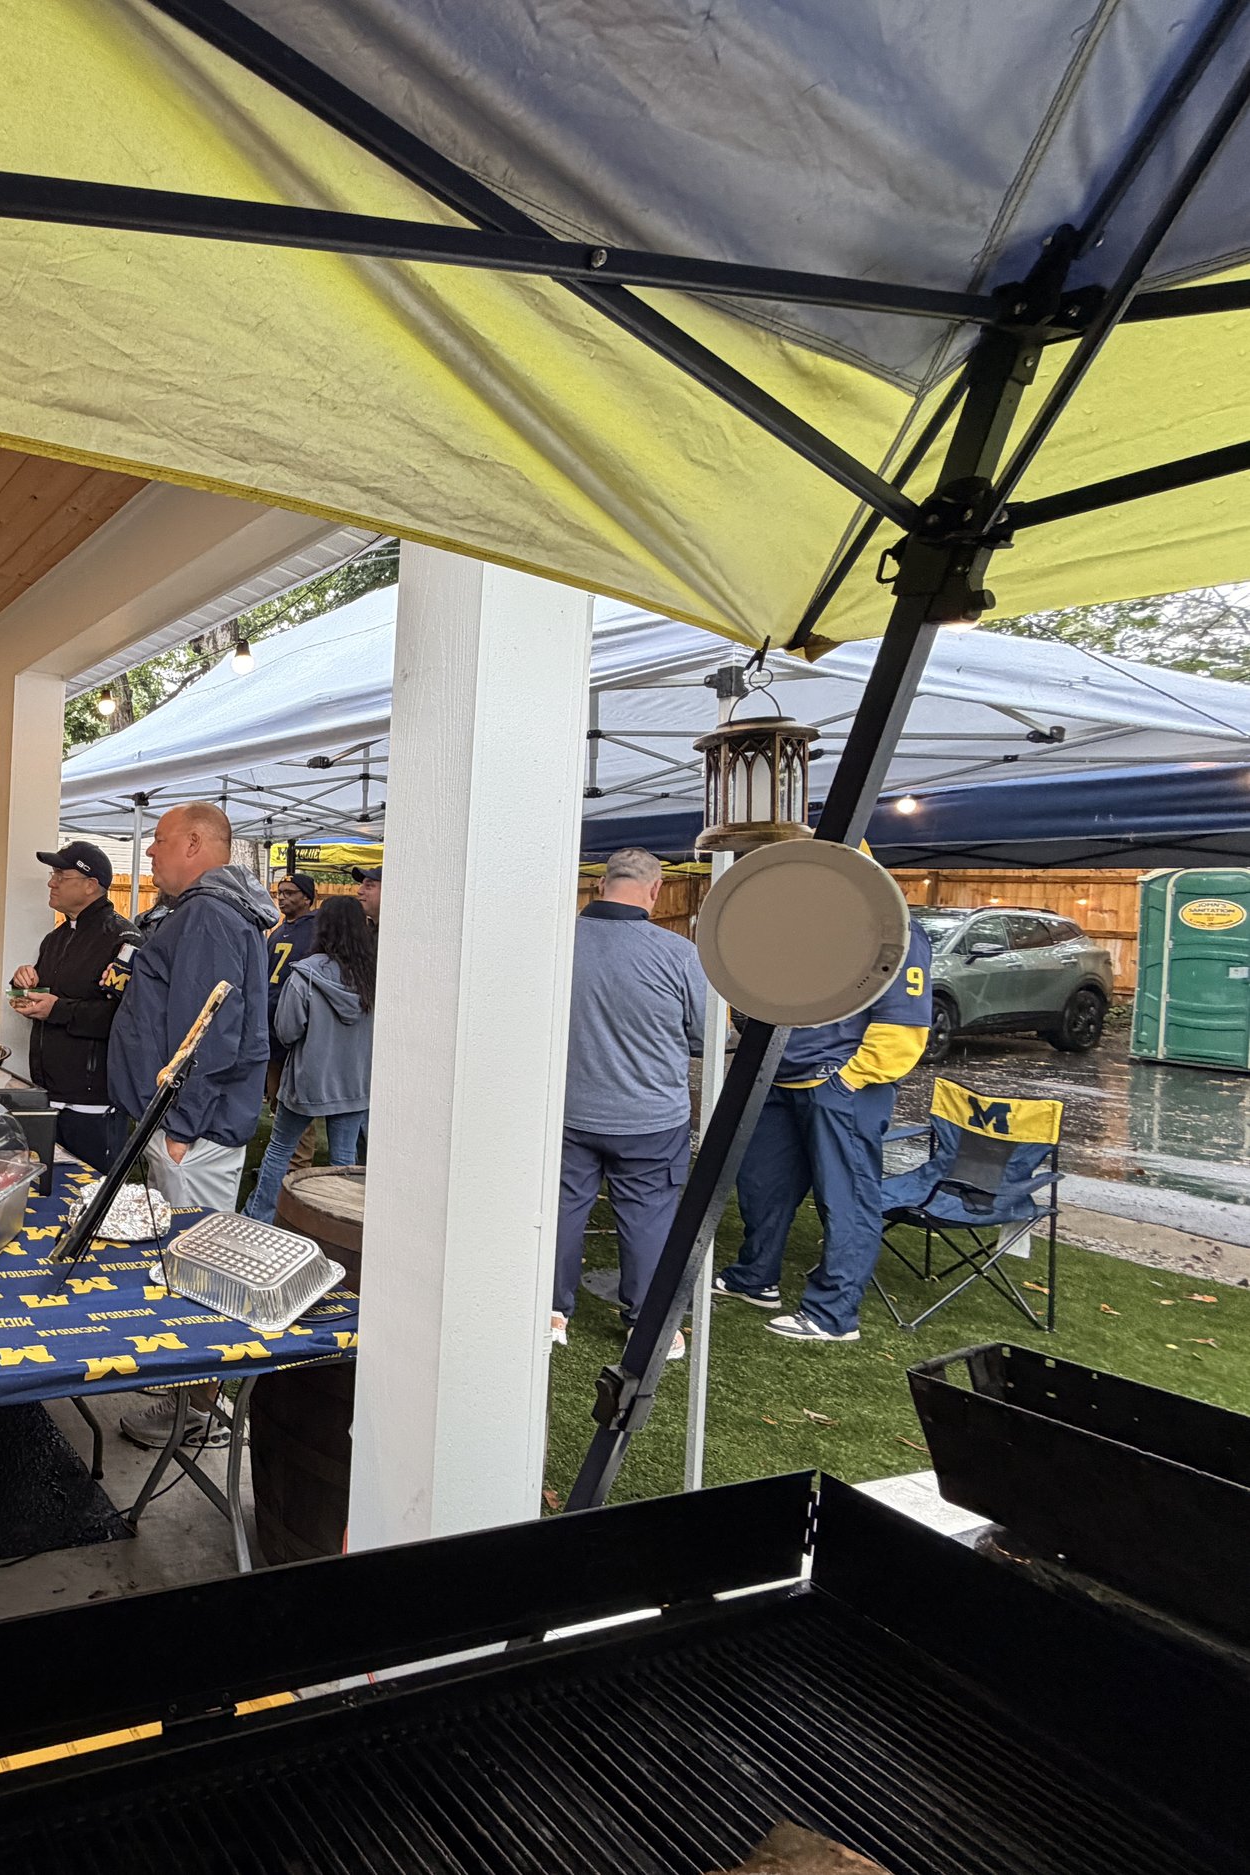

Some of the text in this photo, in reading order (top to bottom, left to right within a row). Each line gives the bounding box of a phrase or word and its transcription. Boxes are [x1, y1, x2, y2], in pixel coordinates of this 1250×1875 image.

[269, 943, 293, 984] 7
[104, 968, 131, 991] M
[906, 966, 924, 997] 9
[968, 1097, 1012, 1134] M
[65, 1276, 118, 1294] M
[18, 1294, 69, 1309] M
[86, 1307, 157, 1322] MICHIGAN
[160, 1314, 233, 1327] MICHIGAN
[36, 1325, 111, 1337] MICHIGAN
[123, 1332, 189, 1353] M
[207, 1340, 272, 1362] M
[76, 1354, 140, 1381] M
